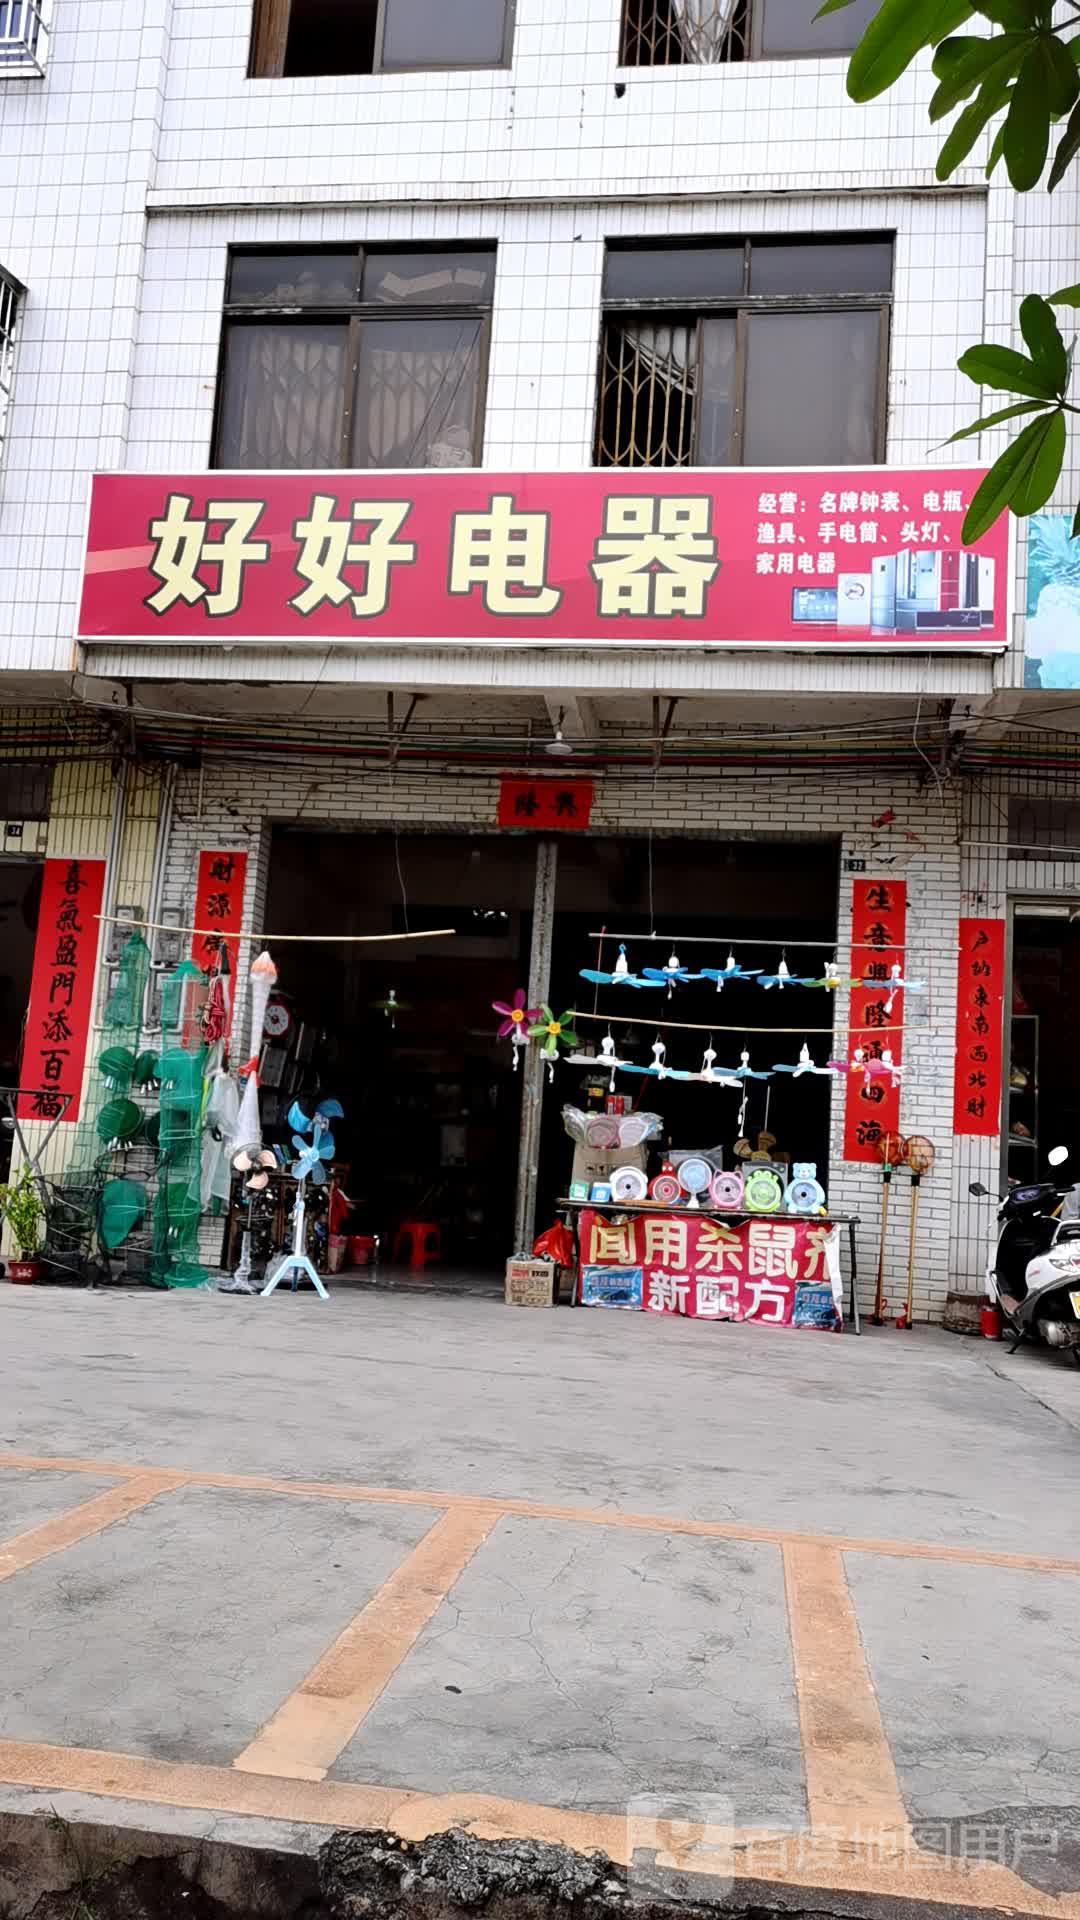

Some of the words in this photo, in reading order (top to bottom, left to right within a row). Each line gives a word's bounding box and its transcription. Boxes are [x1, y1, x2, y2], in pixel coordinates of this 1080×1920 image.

[143, 492, 721, 618] 好好电器
[755, 552, 836, 574] 家用电器
[648, 1270, 790, 1323] 新配方
